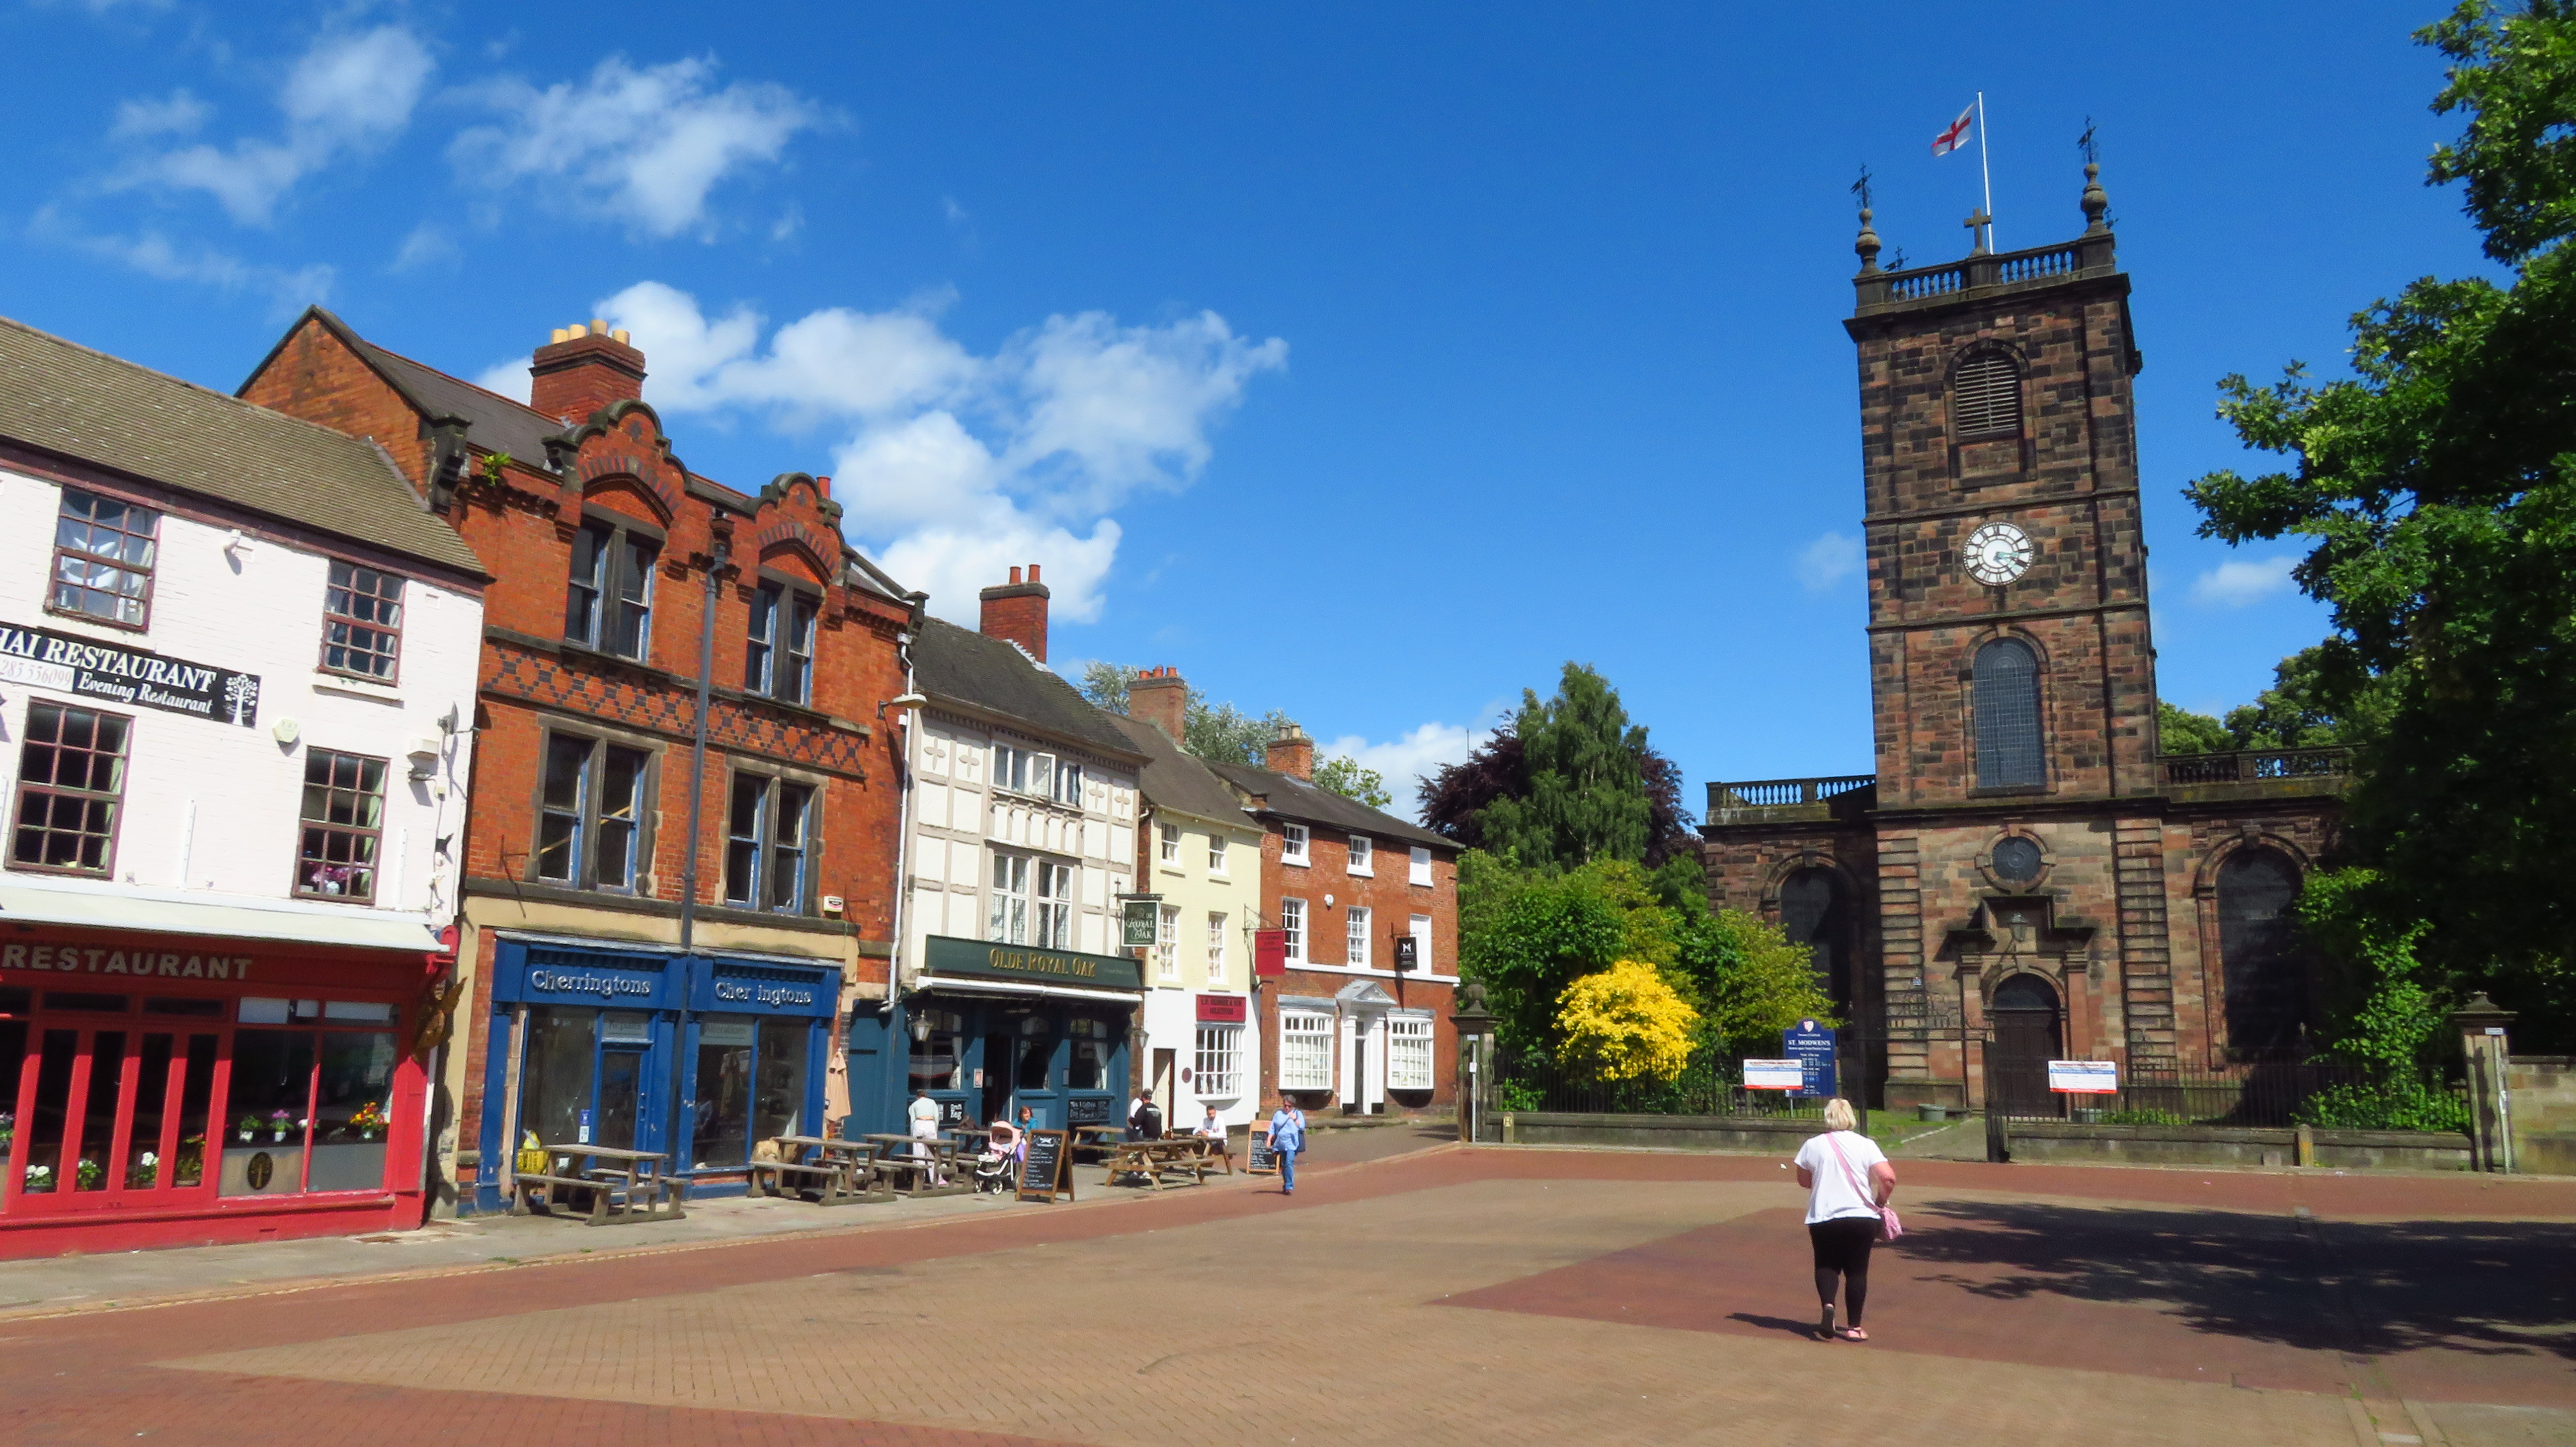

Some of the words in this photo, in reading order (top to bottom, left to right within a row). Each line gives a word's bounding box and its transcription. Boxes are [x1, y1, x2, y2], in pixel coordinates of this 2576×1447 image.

[43, 638, 217, 693] RESTAURANT
[78, 671, 136, 703] Evening
[139, 684, 213, 714] Restaurant
[1, 944, 253, 980] RESTAURANT
[990, 948, 1024, 970] OLDE
[1028, 953, 1068, 975] ROYAL
[1072, 958, 1096, 977] OAK
[532, 970, 651, 999] Cherringtons
